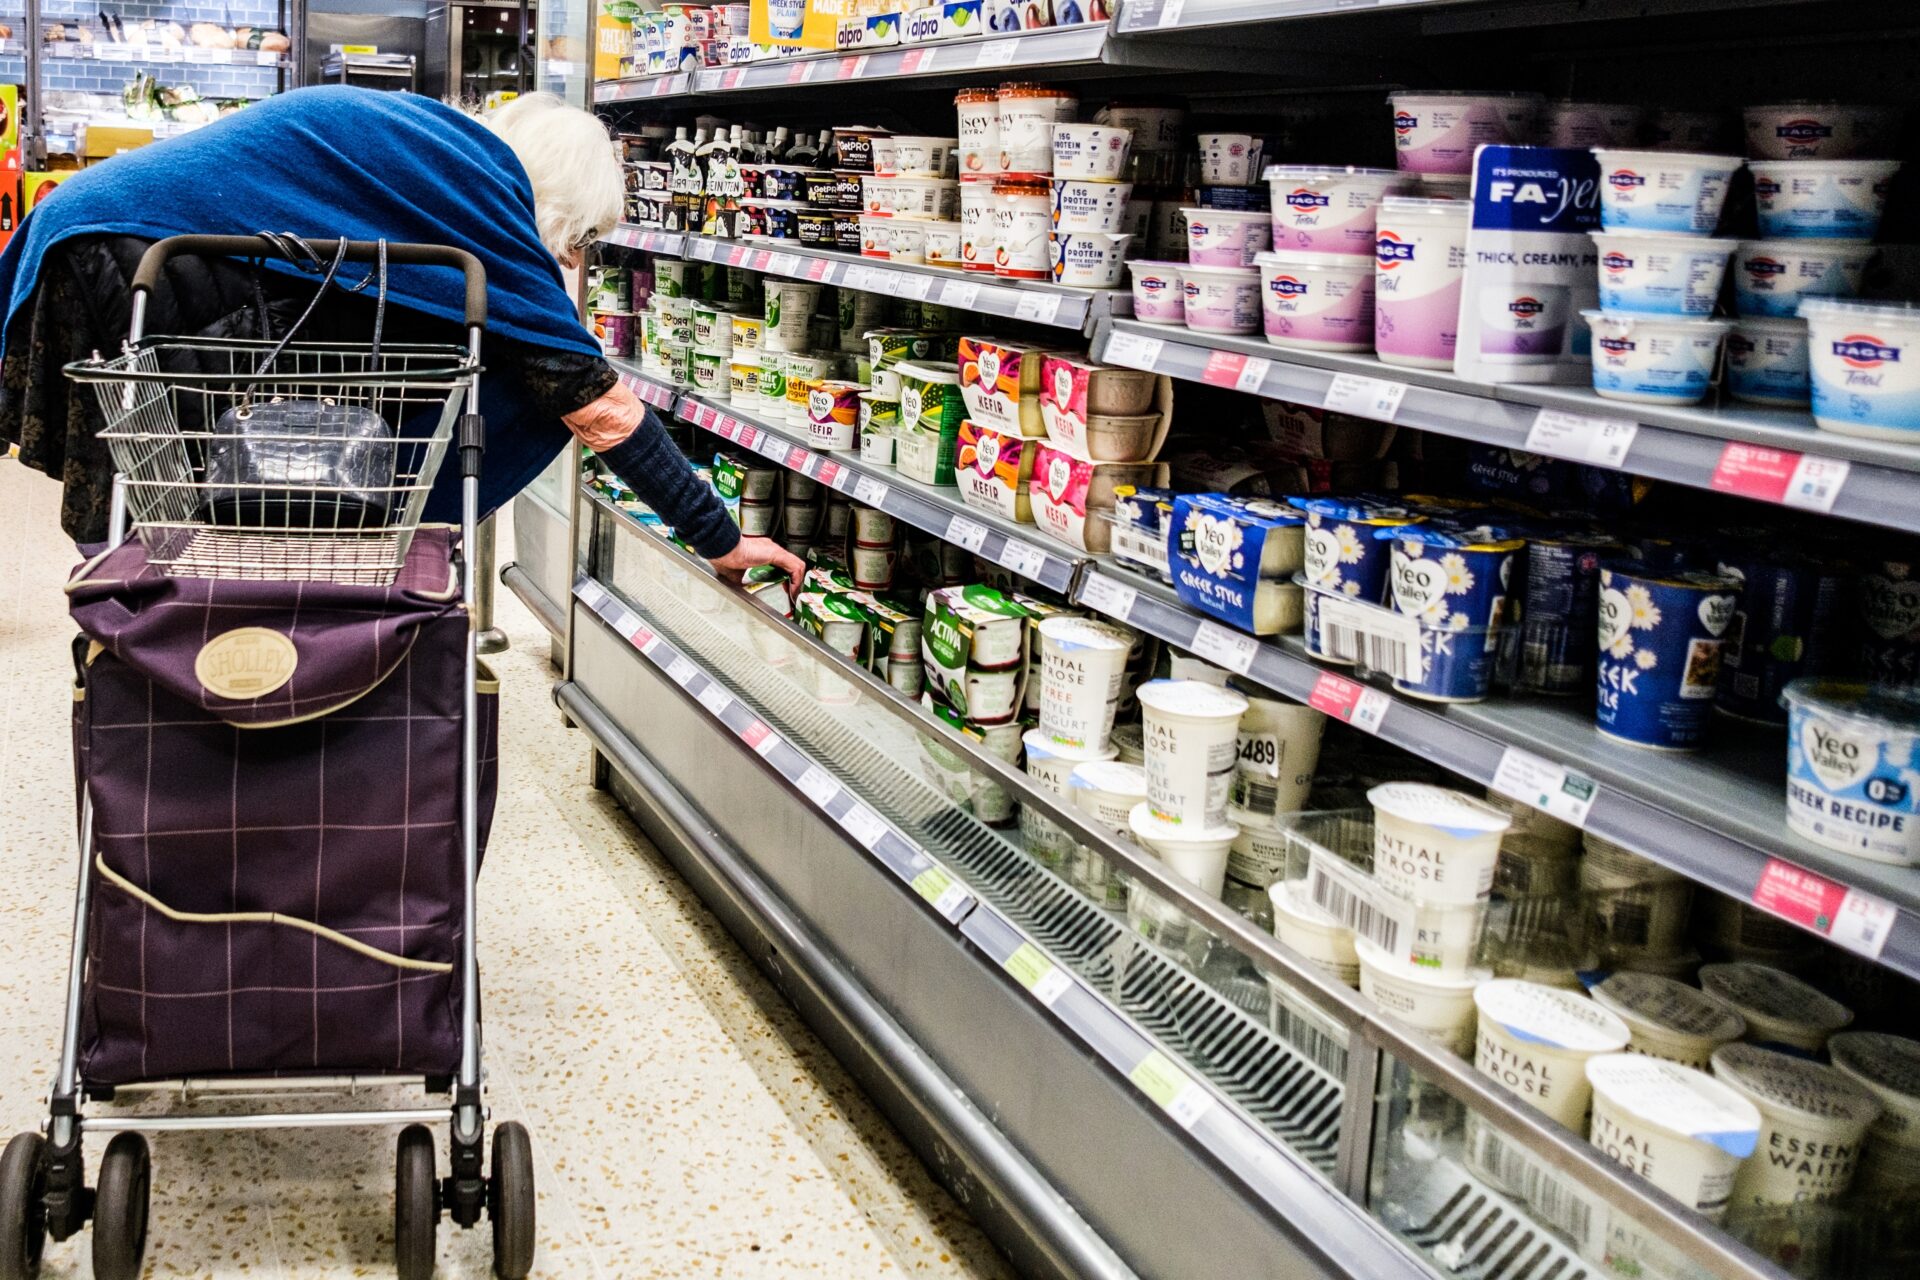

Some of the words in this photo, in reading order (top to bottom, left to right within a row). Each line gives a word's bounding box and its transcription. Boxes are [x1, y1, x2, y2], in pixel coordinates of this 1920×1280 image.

[813, 0, 841, 14] MADE
[837, 24, 863, 47] alpro
[911, 14, 939, 40] alpro
[730, 42, 750, 63] alpro
[1780, 128, 1827, 136] FAGE
[840, 141, 870, 152] GetPRO
[1610, 177, 1642, 185] FAGE
[1063, 197, 1098, 205] PROTEIN
[1288, 195, 1326, 206] FAGE
[1293, 214, 1320, 226] Total
[1067, 250, 1103, 258] PROTEIN
[1476, 252, 1519, 266] THICK,
[1523, 253, 1579, 268] CREAMY,
[1271, 283, 1306, 293] FAGE
[1275, 300, 1299, 312] Total
[1601, 340, 1632, 350] FAGE
[1836, 343, 1895, 359] FAGE
[983, 356, 996, 370] Yeo
[1842, 369, 1884, 387] Total
[813, 393, 828, 406] Yeo
[977, 395, 1004, 415] KEFIR
[1054, 416, 1075, 436] KEFIR
[982, 441, 995, 455] Yeo
[716, 469, 737, 490] ACTIVIA
[1054, 465, 1066, 480] Yeo
[1471, 463, 1497, 477] GREEK
[1499, 470, 1519, 484] STYLE
[972, 479, 999, 499] KEFIR
[1045, 505, 1068, 529] KEFIR
[1204, 522, 1225, 546] Yeo
[1200, 542, 1223, 559] Valley
[1394, 559, 1431, 588] Yeo
[1180, 570, 1214, 596] GREEK
[1214, 584, 1243, 609] STYLE
[1199, 592, 1226, 612] Natural
[930, 618, 961, 652] ACTIVIA
[208, 648, 286, 678] SHOLLEY
[1044, 651, 1086, 673] NTIAL
[1043, 663, 1085, 685] TROSE
[1045, 686, 1073, 703] FREE
[1043, 711, 1088, 730] OGURT
[1813, 726, 1859, 759] Yeo
[1811, 748, 1861, 776] Valley
[1149, 790, 1187, 806] GURT
[1830, 800, 1905, 832] RECIPE
[1379, 849, 1446, 883] TROSE
[1417, 928, 1441, 943] RT
[1482, 1054, 1551, 1098] TROSE
[1769, 1131, 1850, 1160] ESSEN
